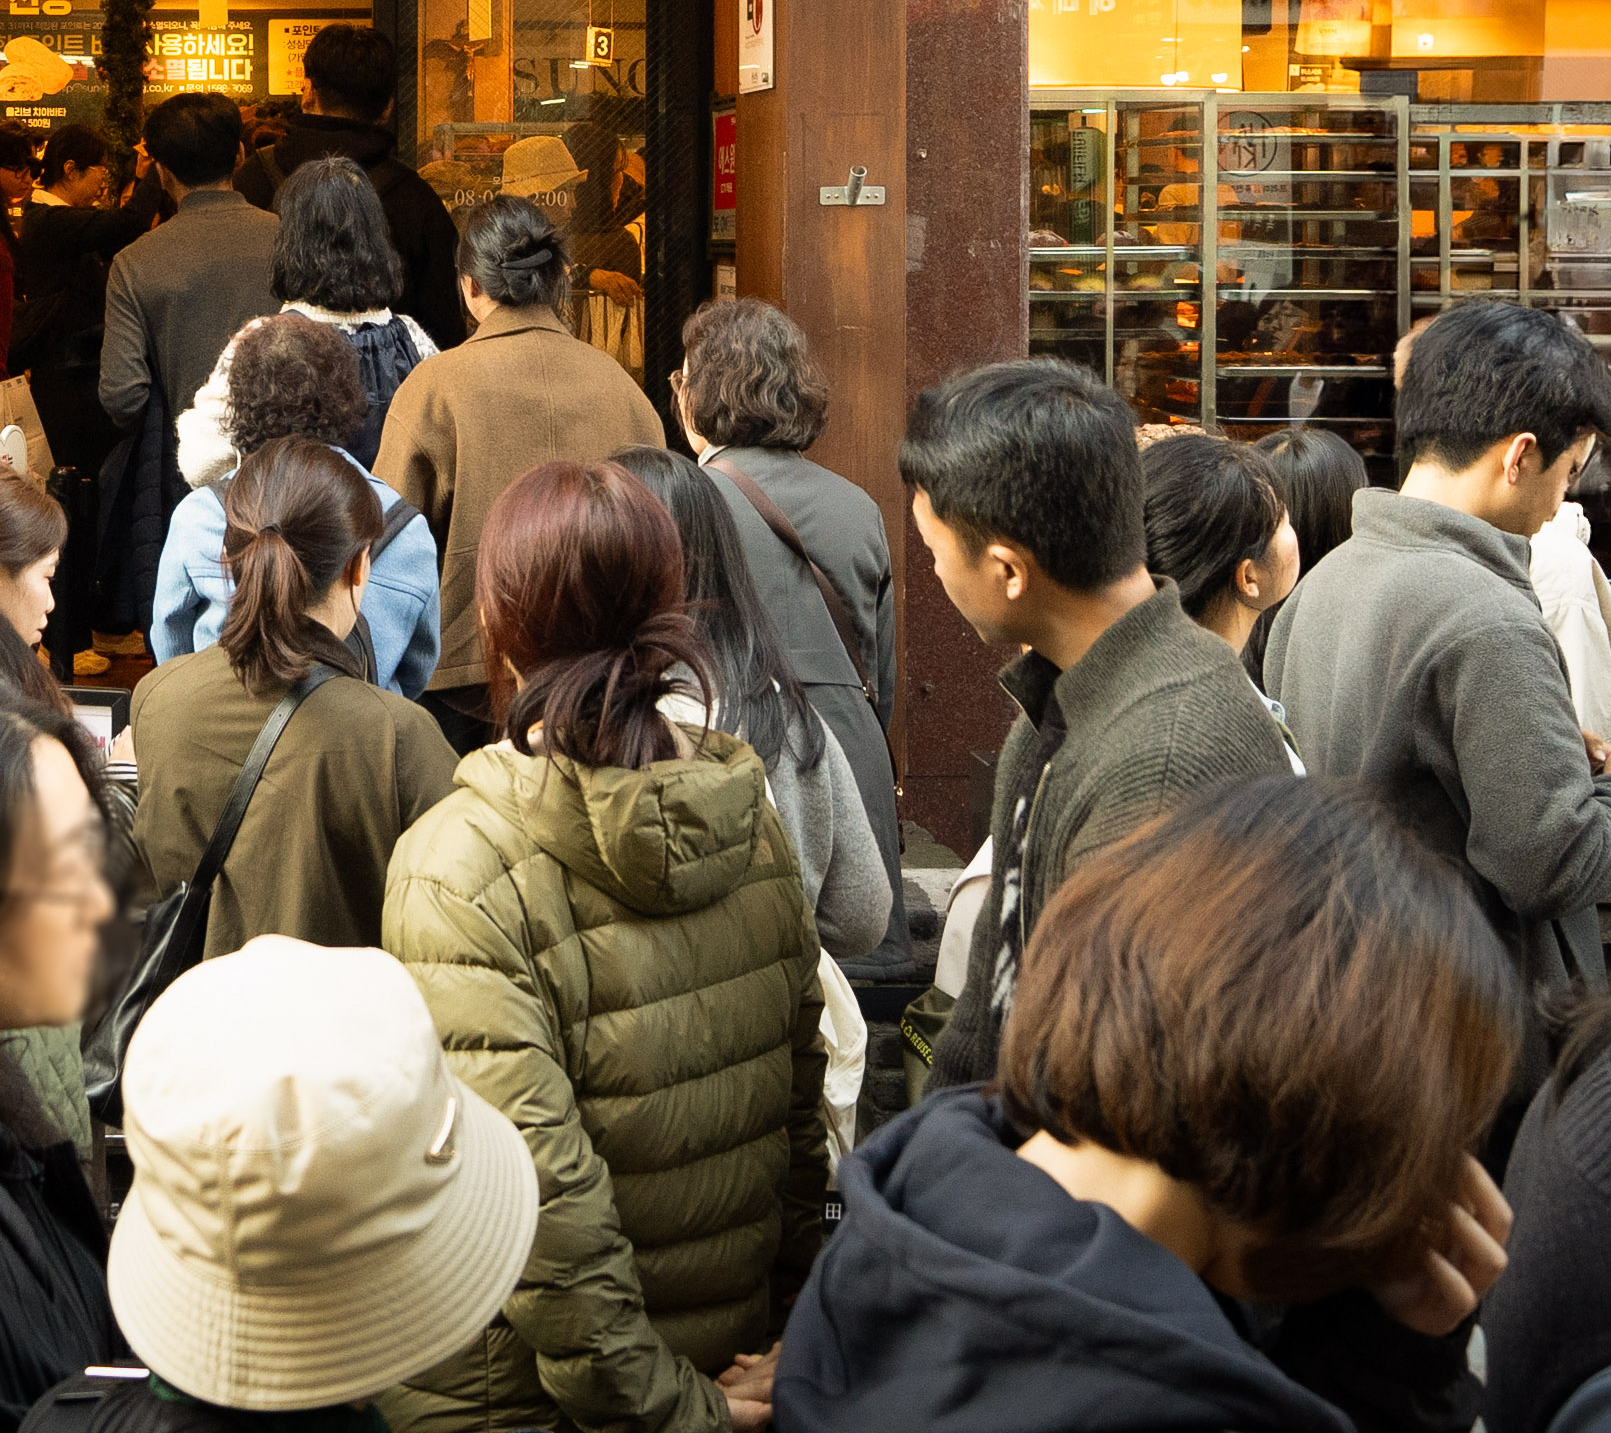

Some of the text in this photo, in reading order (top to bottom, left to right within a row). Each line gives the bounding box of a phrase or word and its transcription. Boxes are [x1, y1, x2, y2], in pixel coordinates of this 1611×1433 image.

[145, 33, 255, 56] 사용하세요!
[596, 36, 609, 56] 3
[143, 58, 254, 81] 소멸됩니다
